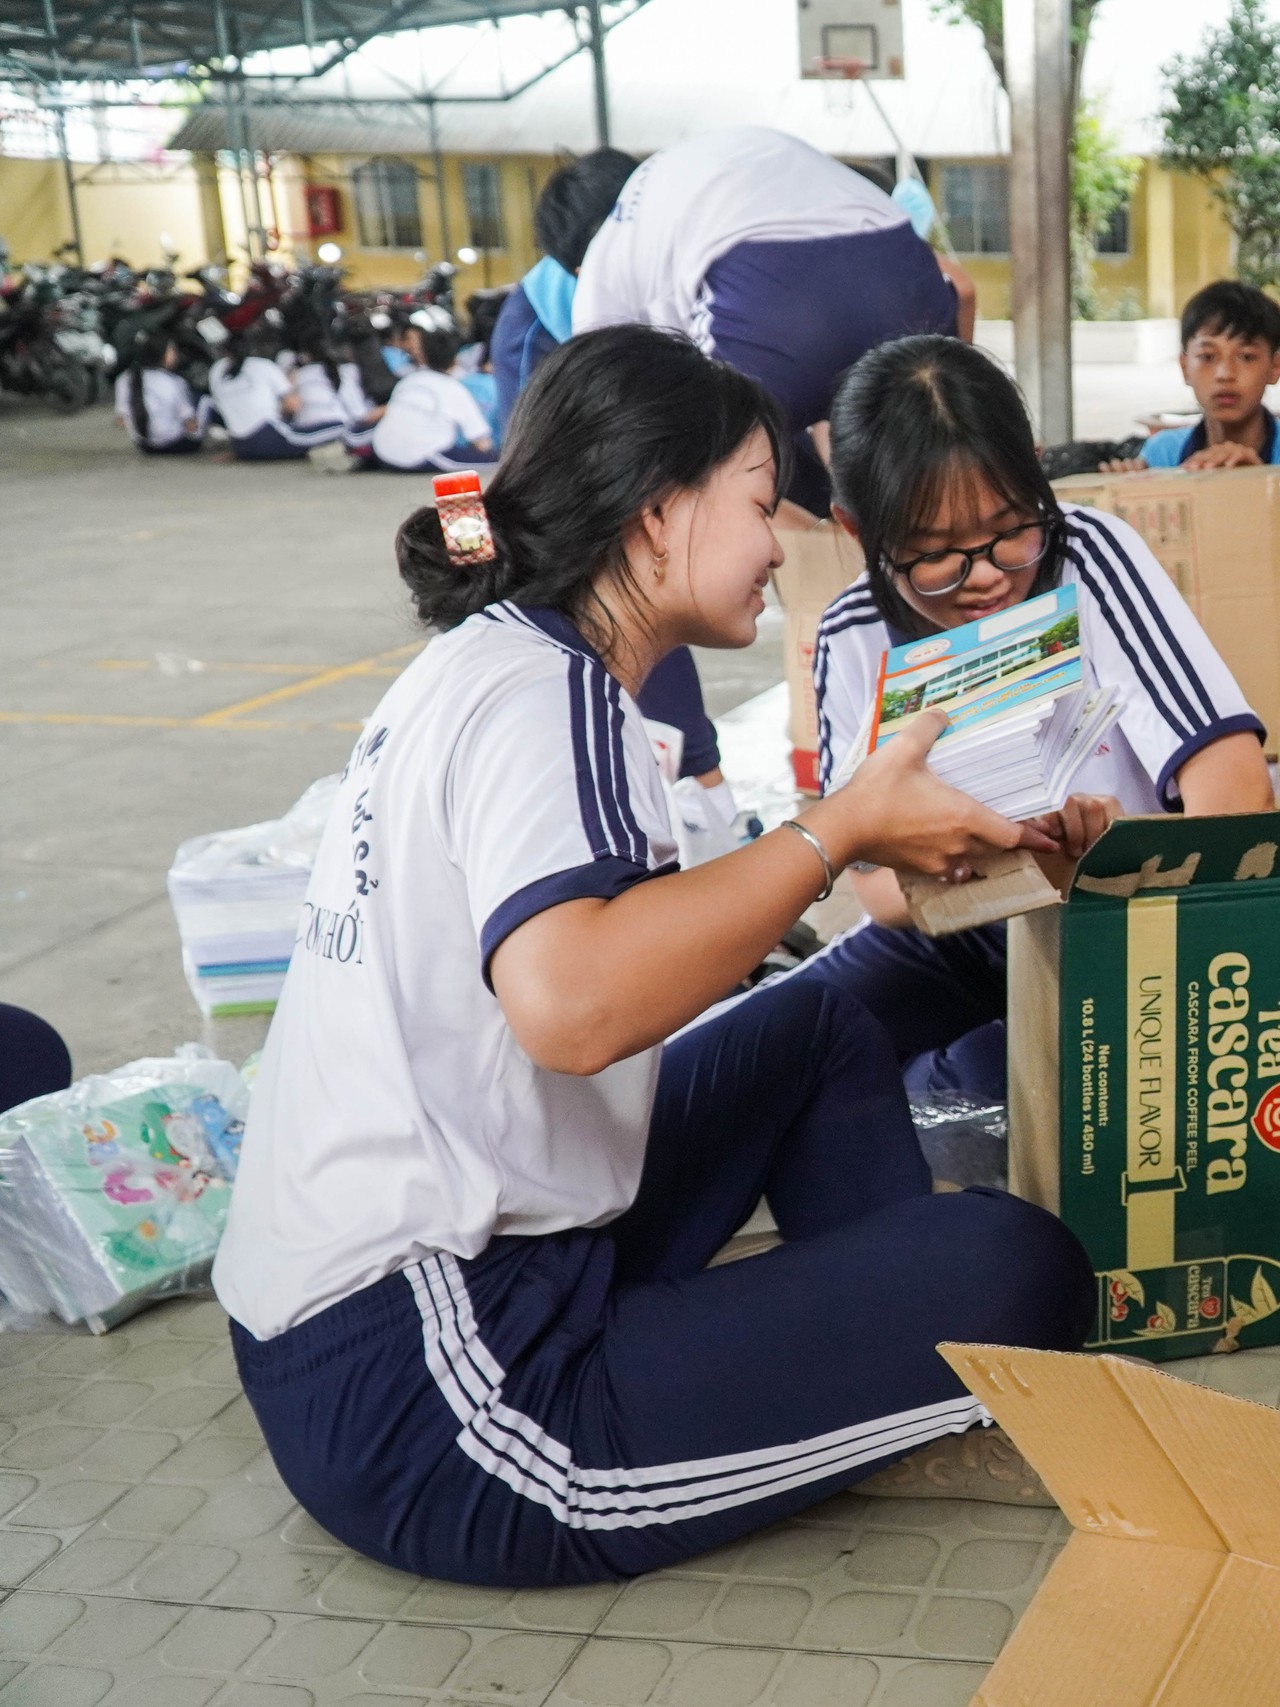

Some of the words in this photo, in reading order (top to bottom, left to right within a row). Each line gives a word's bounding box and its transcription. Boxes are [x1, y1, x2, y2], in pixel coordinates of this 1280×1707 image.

[1082, 998, 1093, 1027] 10.8
[1134, 975, 1163, 1069] UNIQUE
[1187, 981, 1200, 1045] CASCARA
[1080, 1040, 1095, 1062] (24
[1082, 1029, 1093, 1038] L
[1097, 1044, 1110, 1069] Net
[1187, 1047, 1199, 1085] FROM
[1205, 951, 1251, 1196] cascara
[1082, 1064, 1094, 1111] bottles
[1097, 1071, 1110, 1127] content:
[1082, 1114, 1091, 1122] x
[1138, 1078, 1163, 1169] FLAVOR
[1186, 1088, 1199, 1138] COFFEE
[1082, 1124, 1093, 1150] 450
[1185, 1141, 1198, 1172] PEEL
[1081, 1153, 1094, 1175] ml)
[1121, 1165, 1188, 1206] 1
[1186, 1265, 1201, 1329] cascara
